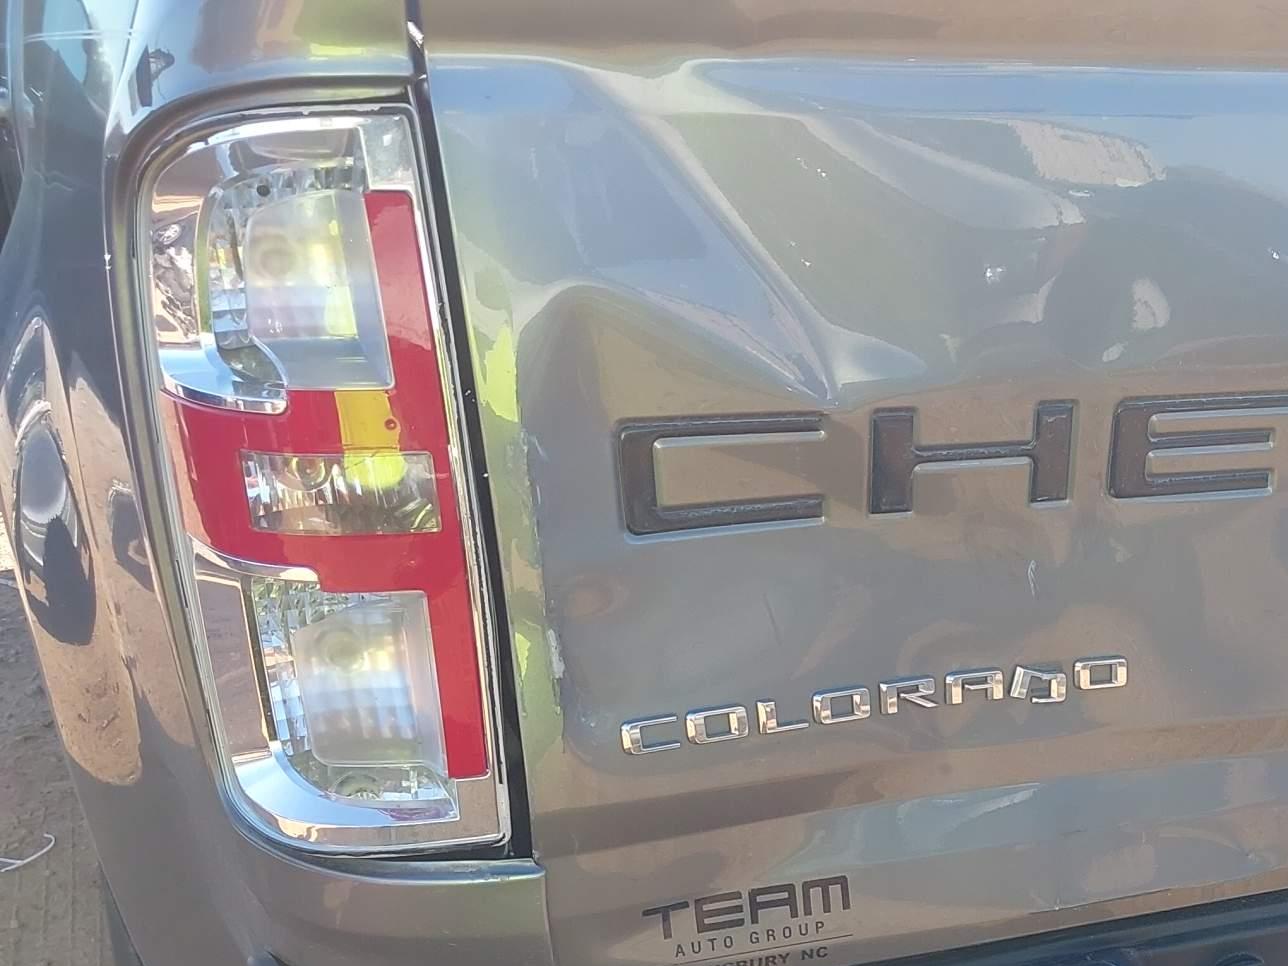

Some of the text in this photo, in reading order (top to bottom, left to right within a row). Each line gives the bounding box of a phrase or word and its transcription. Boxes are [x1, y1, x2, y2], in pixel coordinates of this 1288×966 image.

[620, 655, 1129, 755] COLORADO
[641, 874, 851, 940] TEAM
[675, 920, 826, 958] AUTO GROUP
[801, 946, 829, 961] NC
